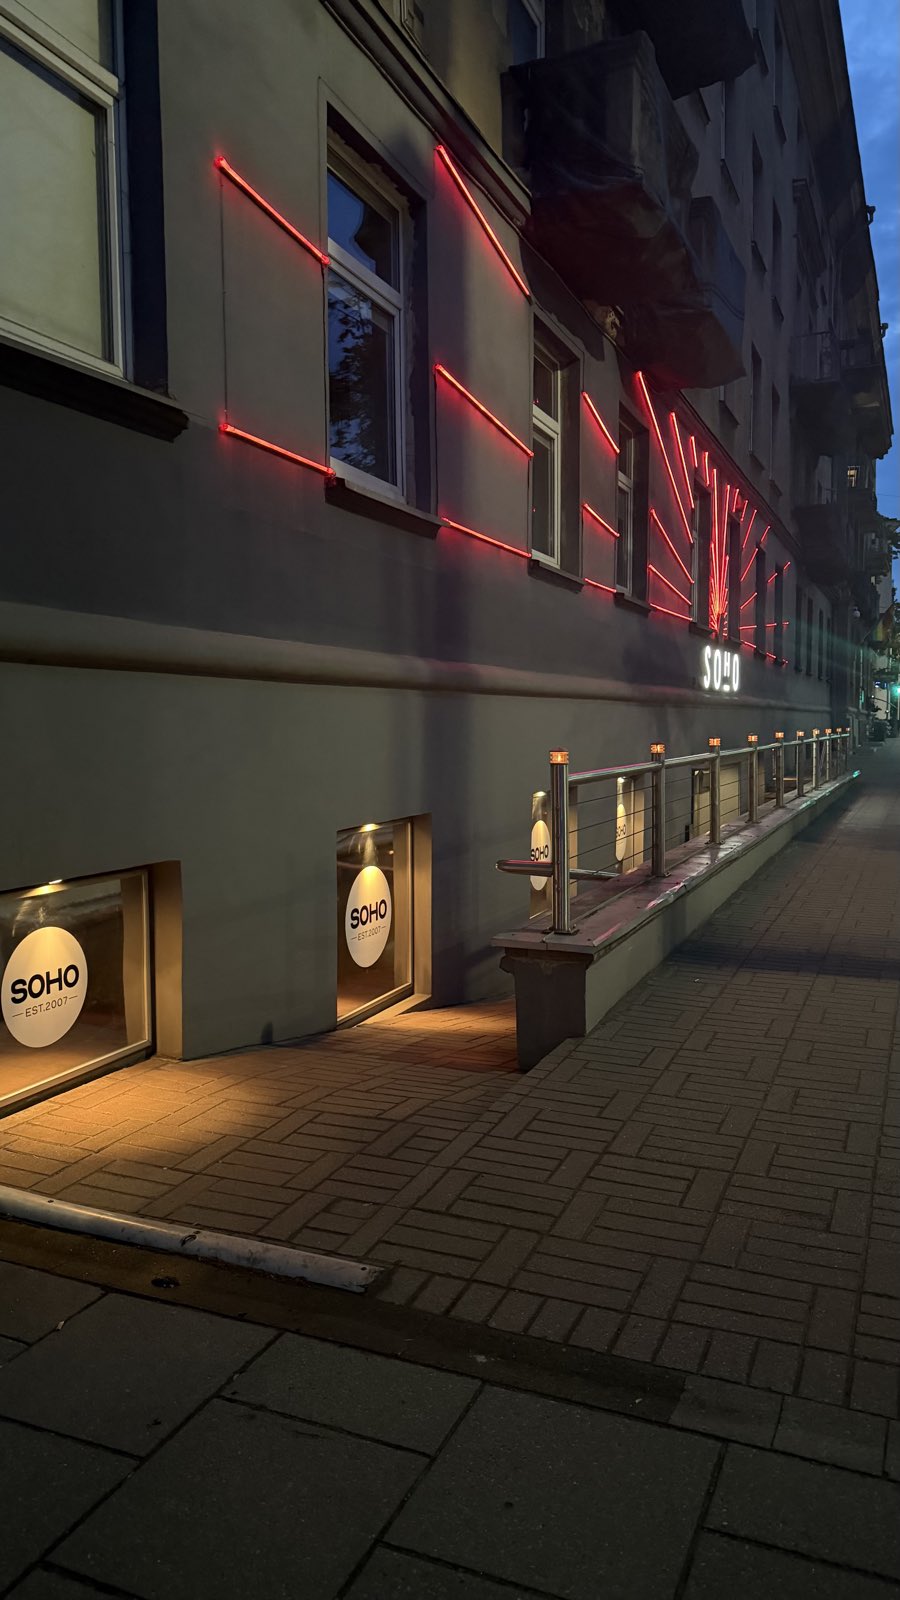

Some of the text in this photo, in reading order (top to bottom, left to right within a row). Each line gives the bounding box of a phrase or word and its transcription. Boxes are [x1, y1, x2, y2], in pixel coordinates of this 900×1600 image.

[704, 645, 739, 691] SOHO
[530, 844, 549, 861] SOHO
[350, 899, 387, 929] SOHO
[11, 964, 80, 1004] SOHO
[25, 996, 68, 1018] EST.2007
